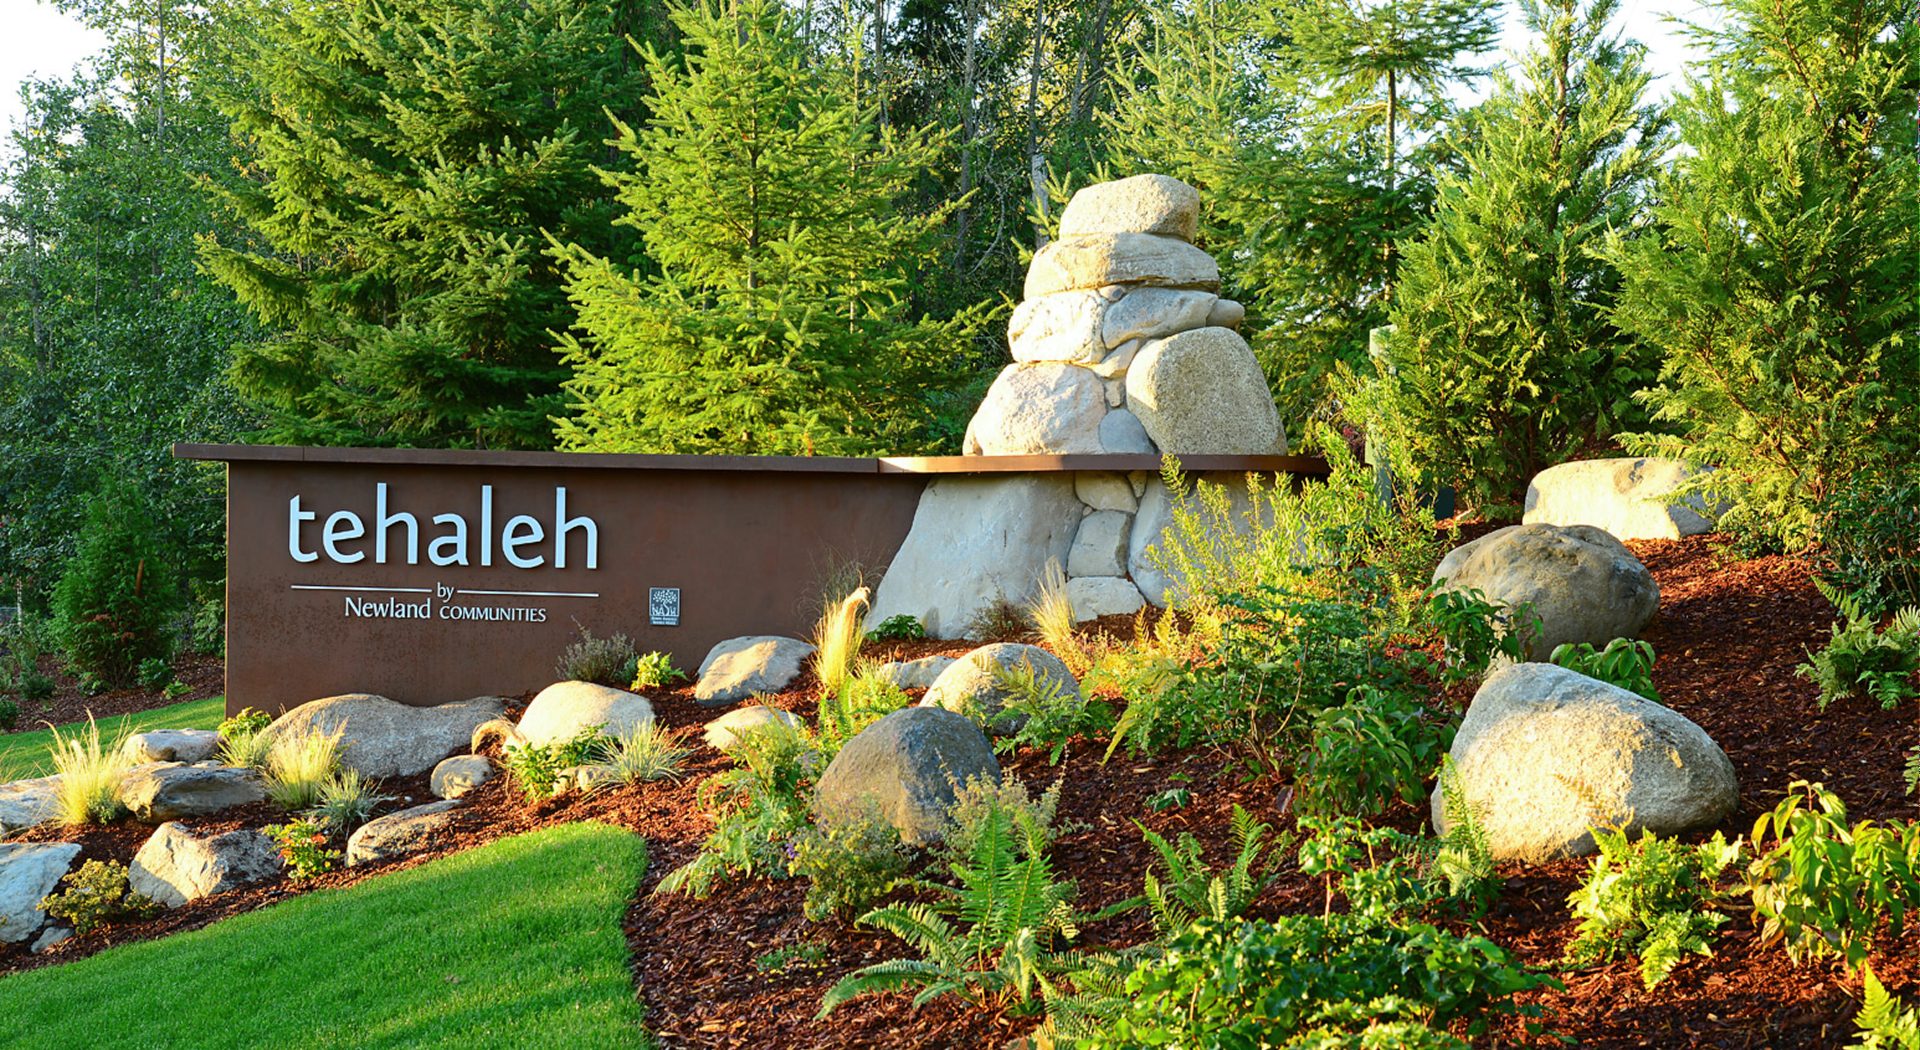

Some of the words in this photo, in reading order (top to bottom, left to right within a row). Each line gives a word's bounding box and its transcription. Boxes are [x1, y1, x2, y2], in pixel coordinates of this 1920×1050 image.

[288, 482, 599, 570] tehaleh
[436, 582, 455, 603] by
[344, 597, 431, 620] Newland
[439, 605, 547, 622] COMMUNITIES
